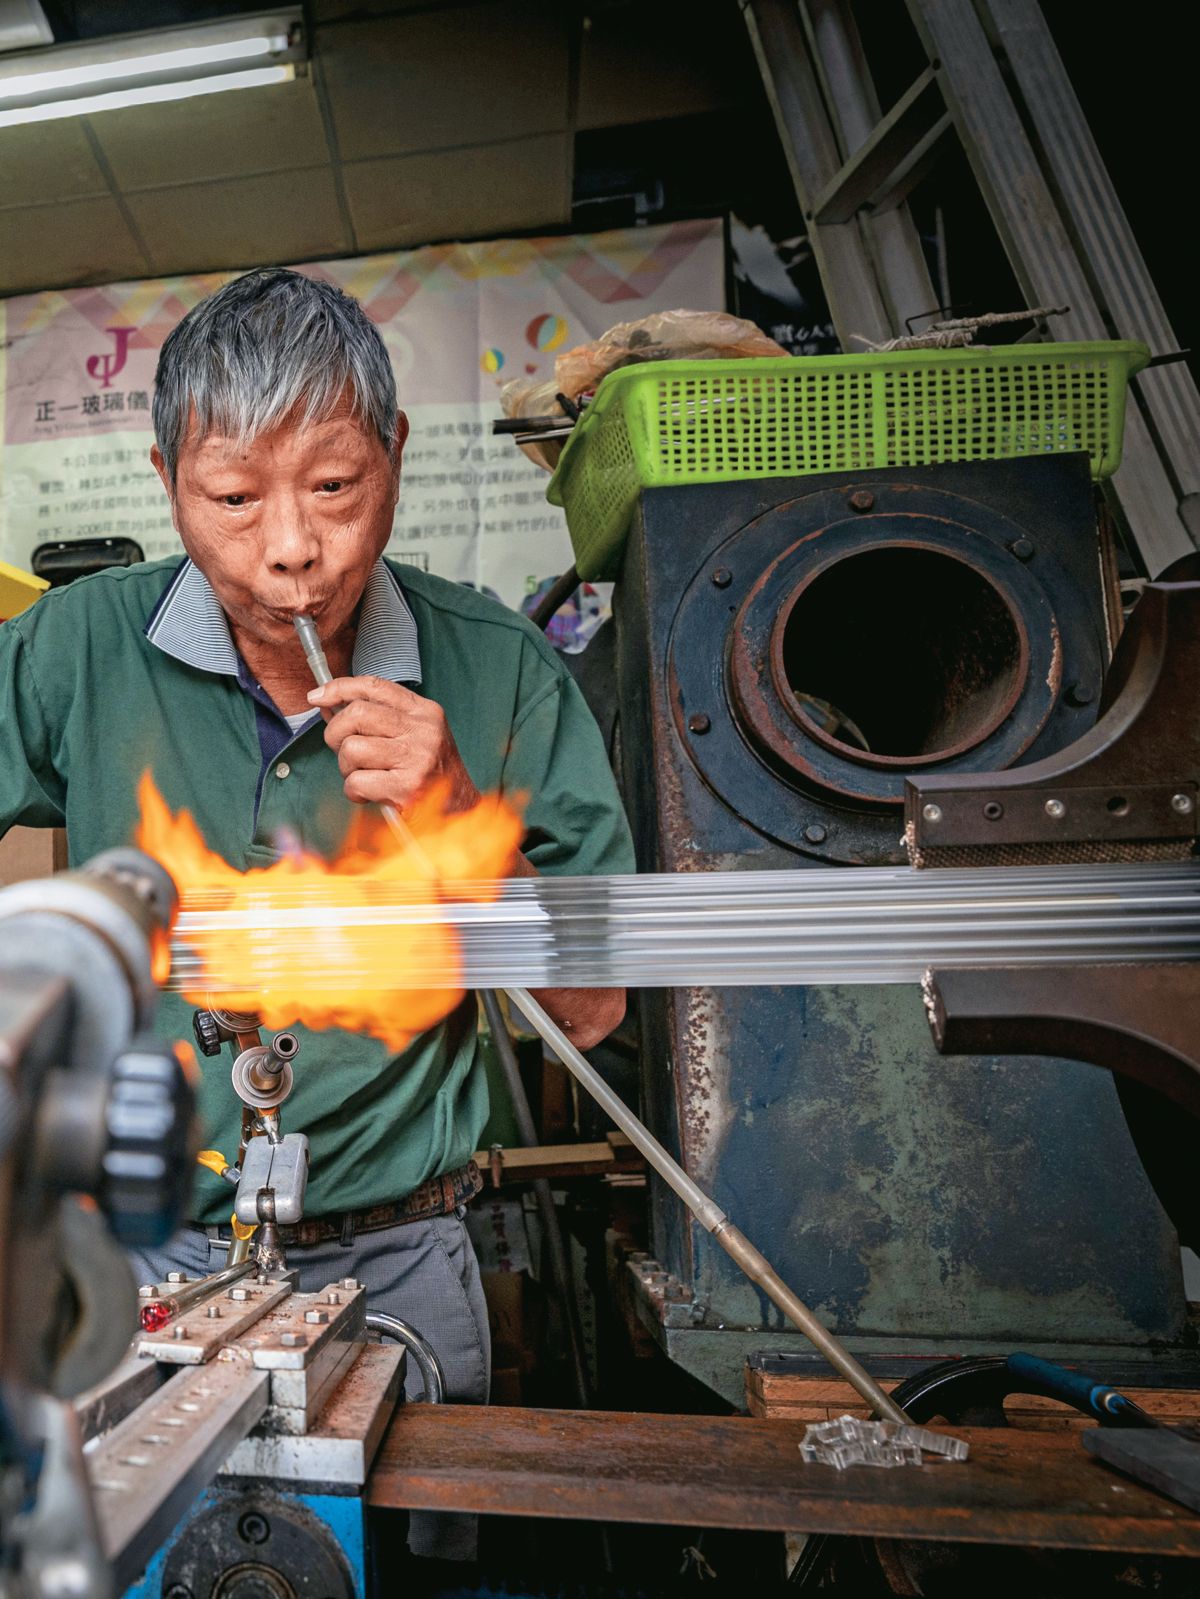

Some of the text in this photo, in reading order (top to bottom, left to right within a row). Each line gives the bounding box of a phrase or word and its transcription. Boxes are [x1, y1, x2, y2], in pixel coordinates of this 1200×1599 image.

[35, 391, 150, 421] 正一玻璃儀
[524, 575, 538, 592] 5
